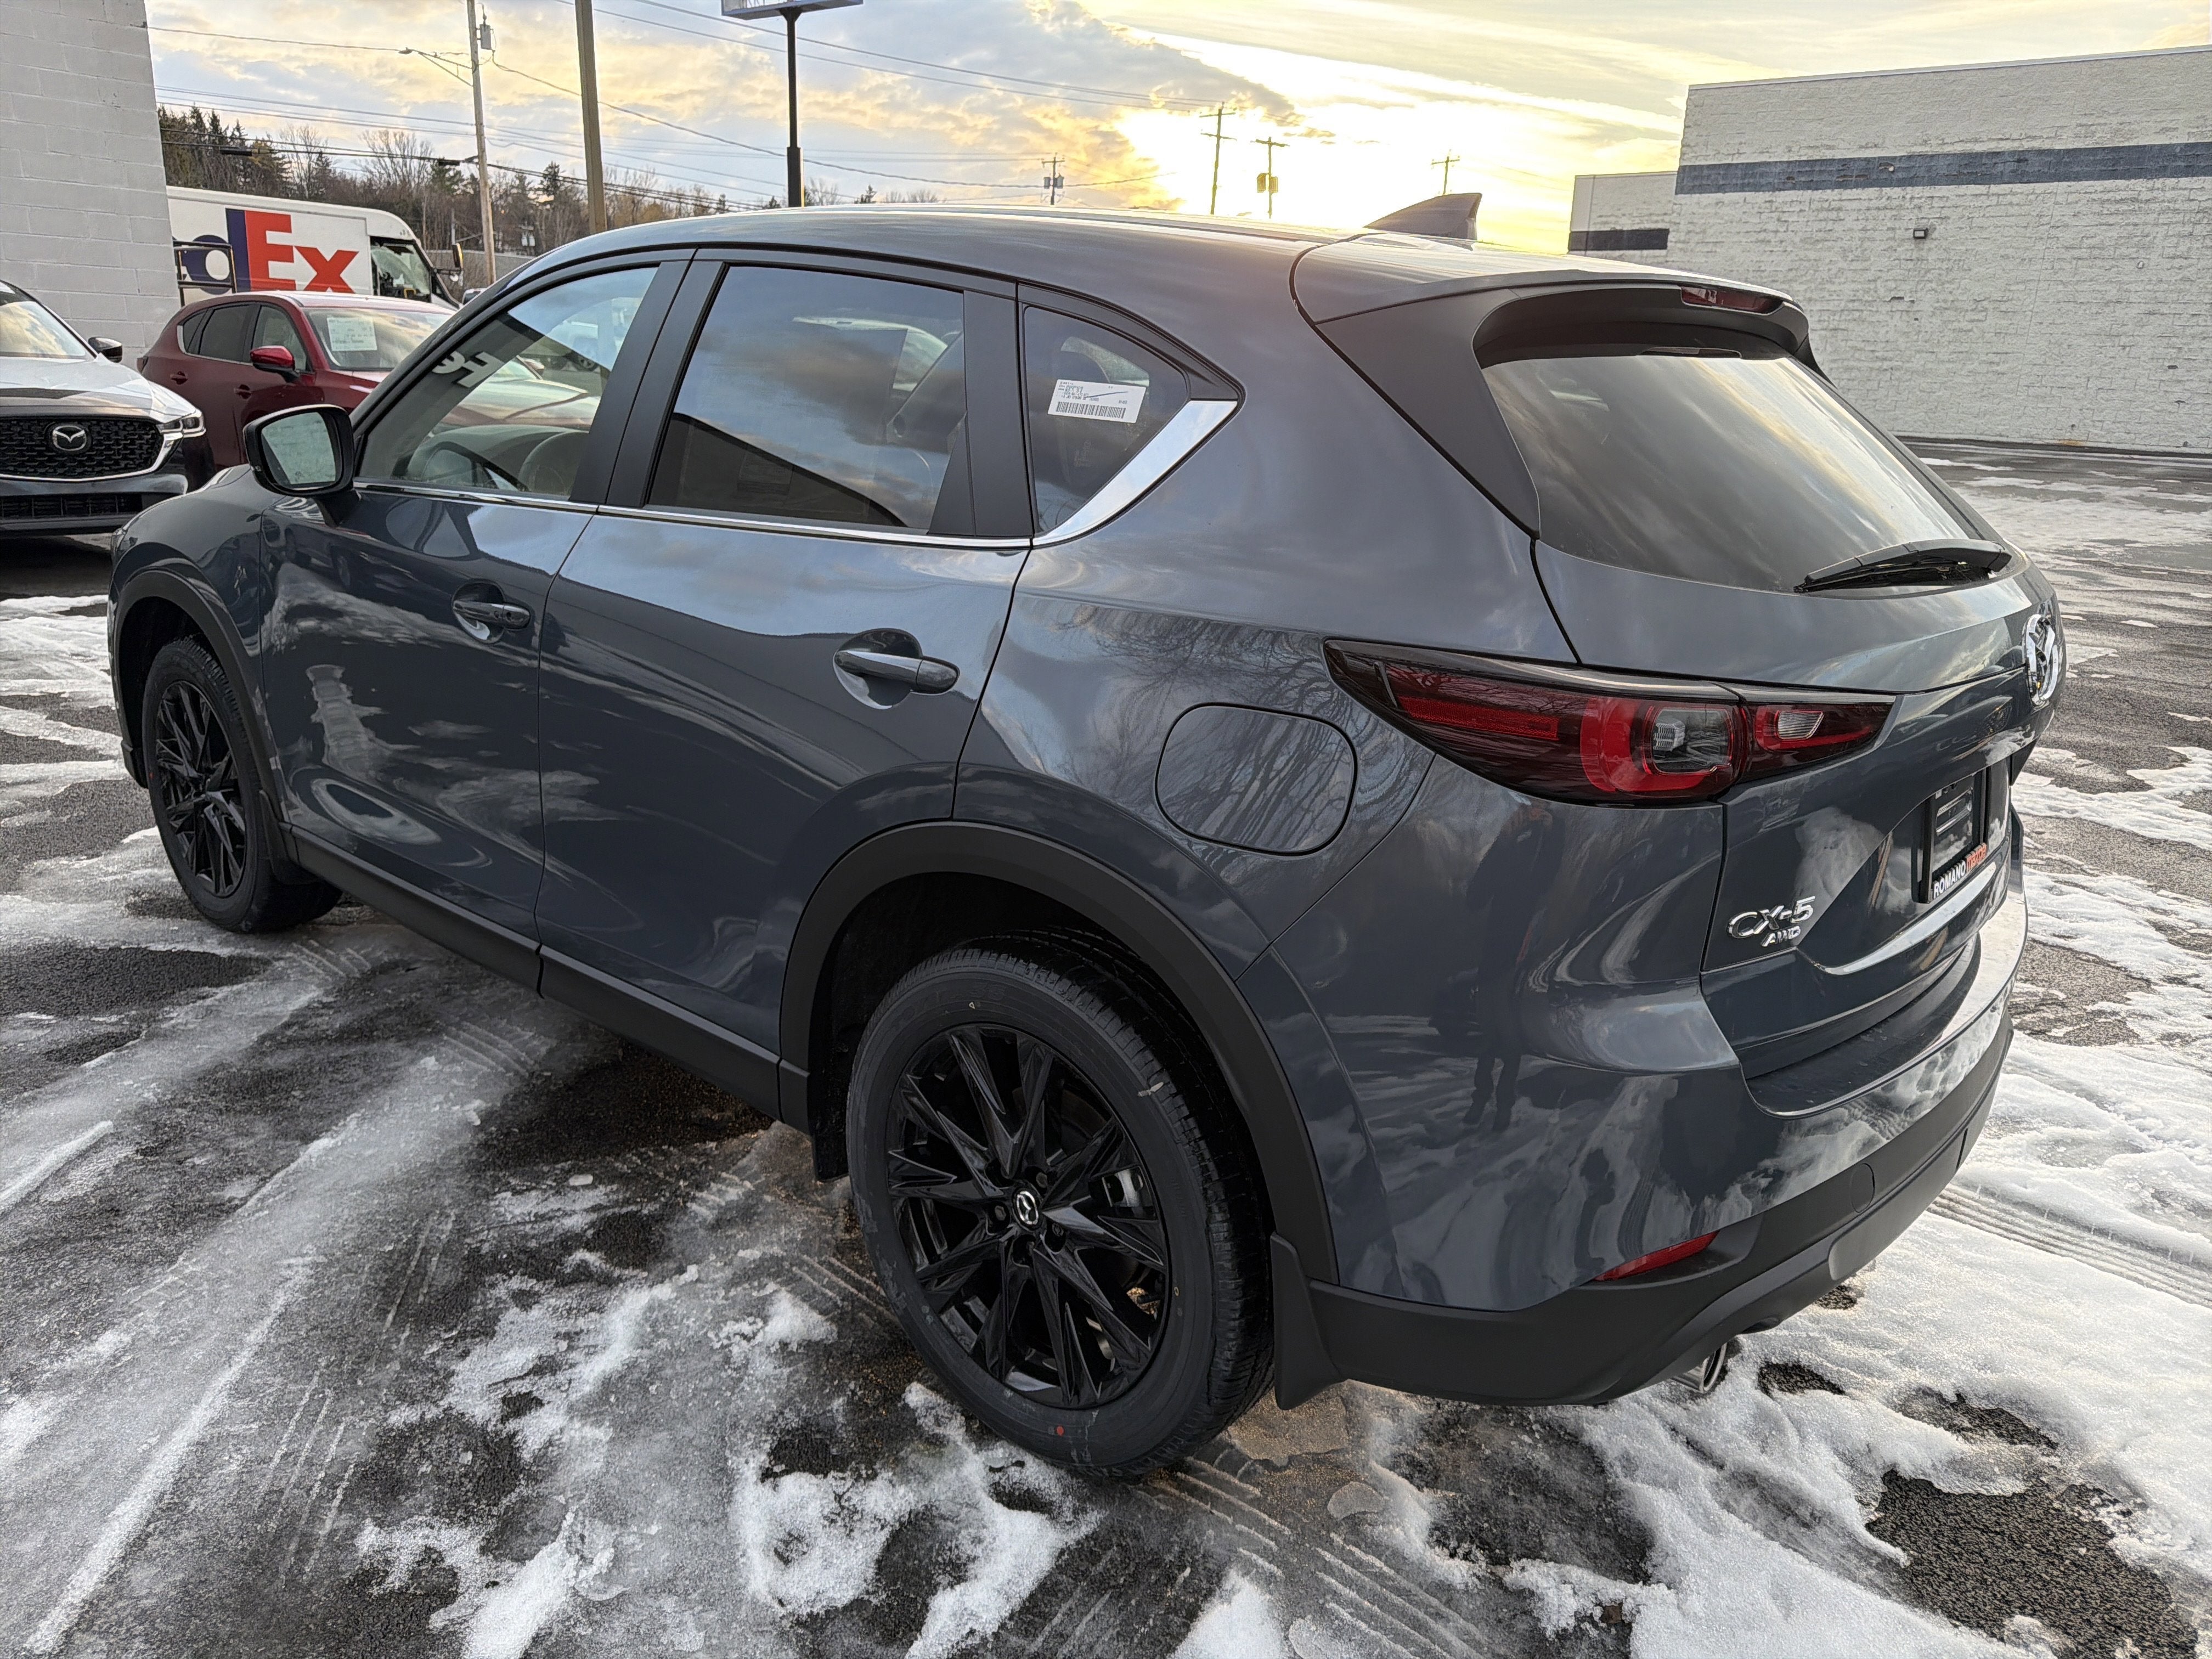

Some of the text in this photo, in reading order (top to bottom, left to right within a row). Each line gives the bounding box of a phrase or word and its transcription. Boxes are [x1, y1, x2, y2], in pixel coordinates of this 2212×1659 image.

[172, 208, 359, 295] dEx
[1933, 860, 1967, 899] ROMANO
[1726, 895, 1816, 939] CX-5
[1760, 926, 1801, 947] AWD
